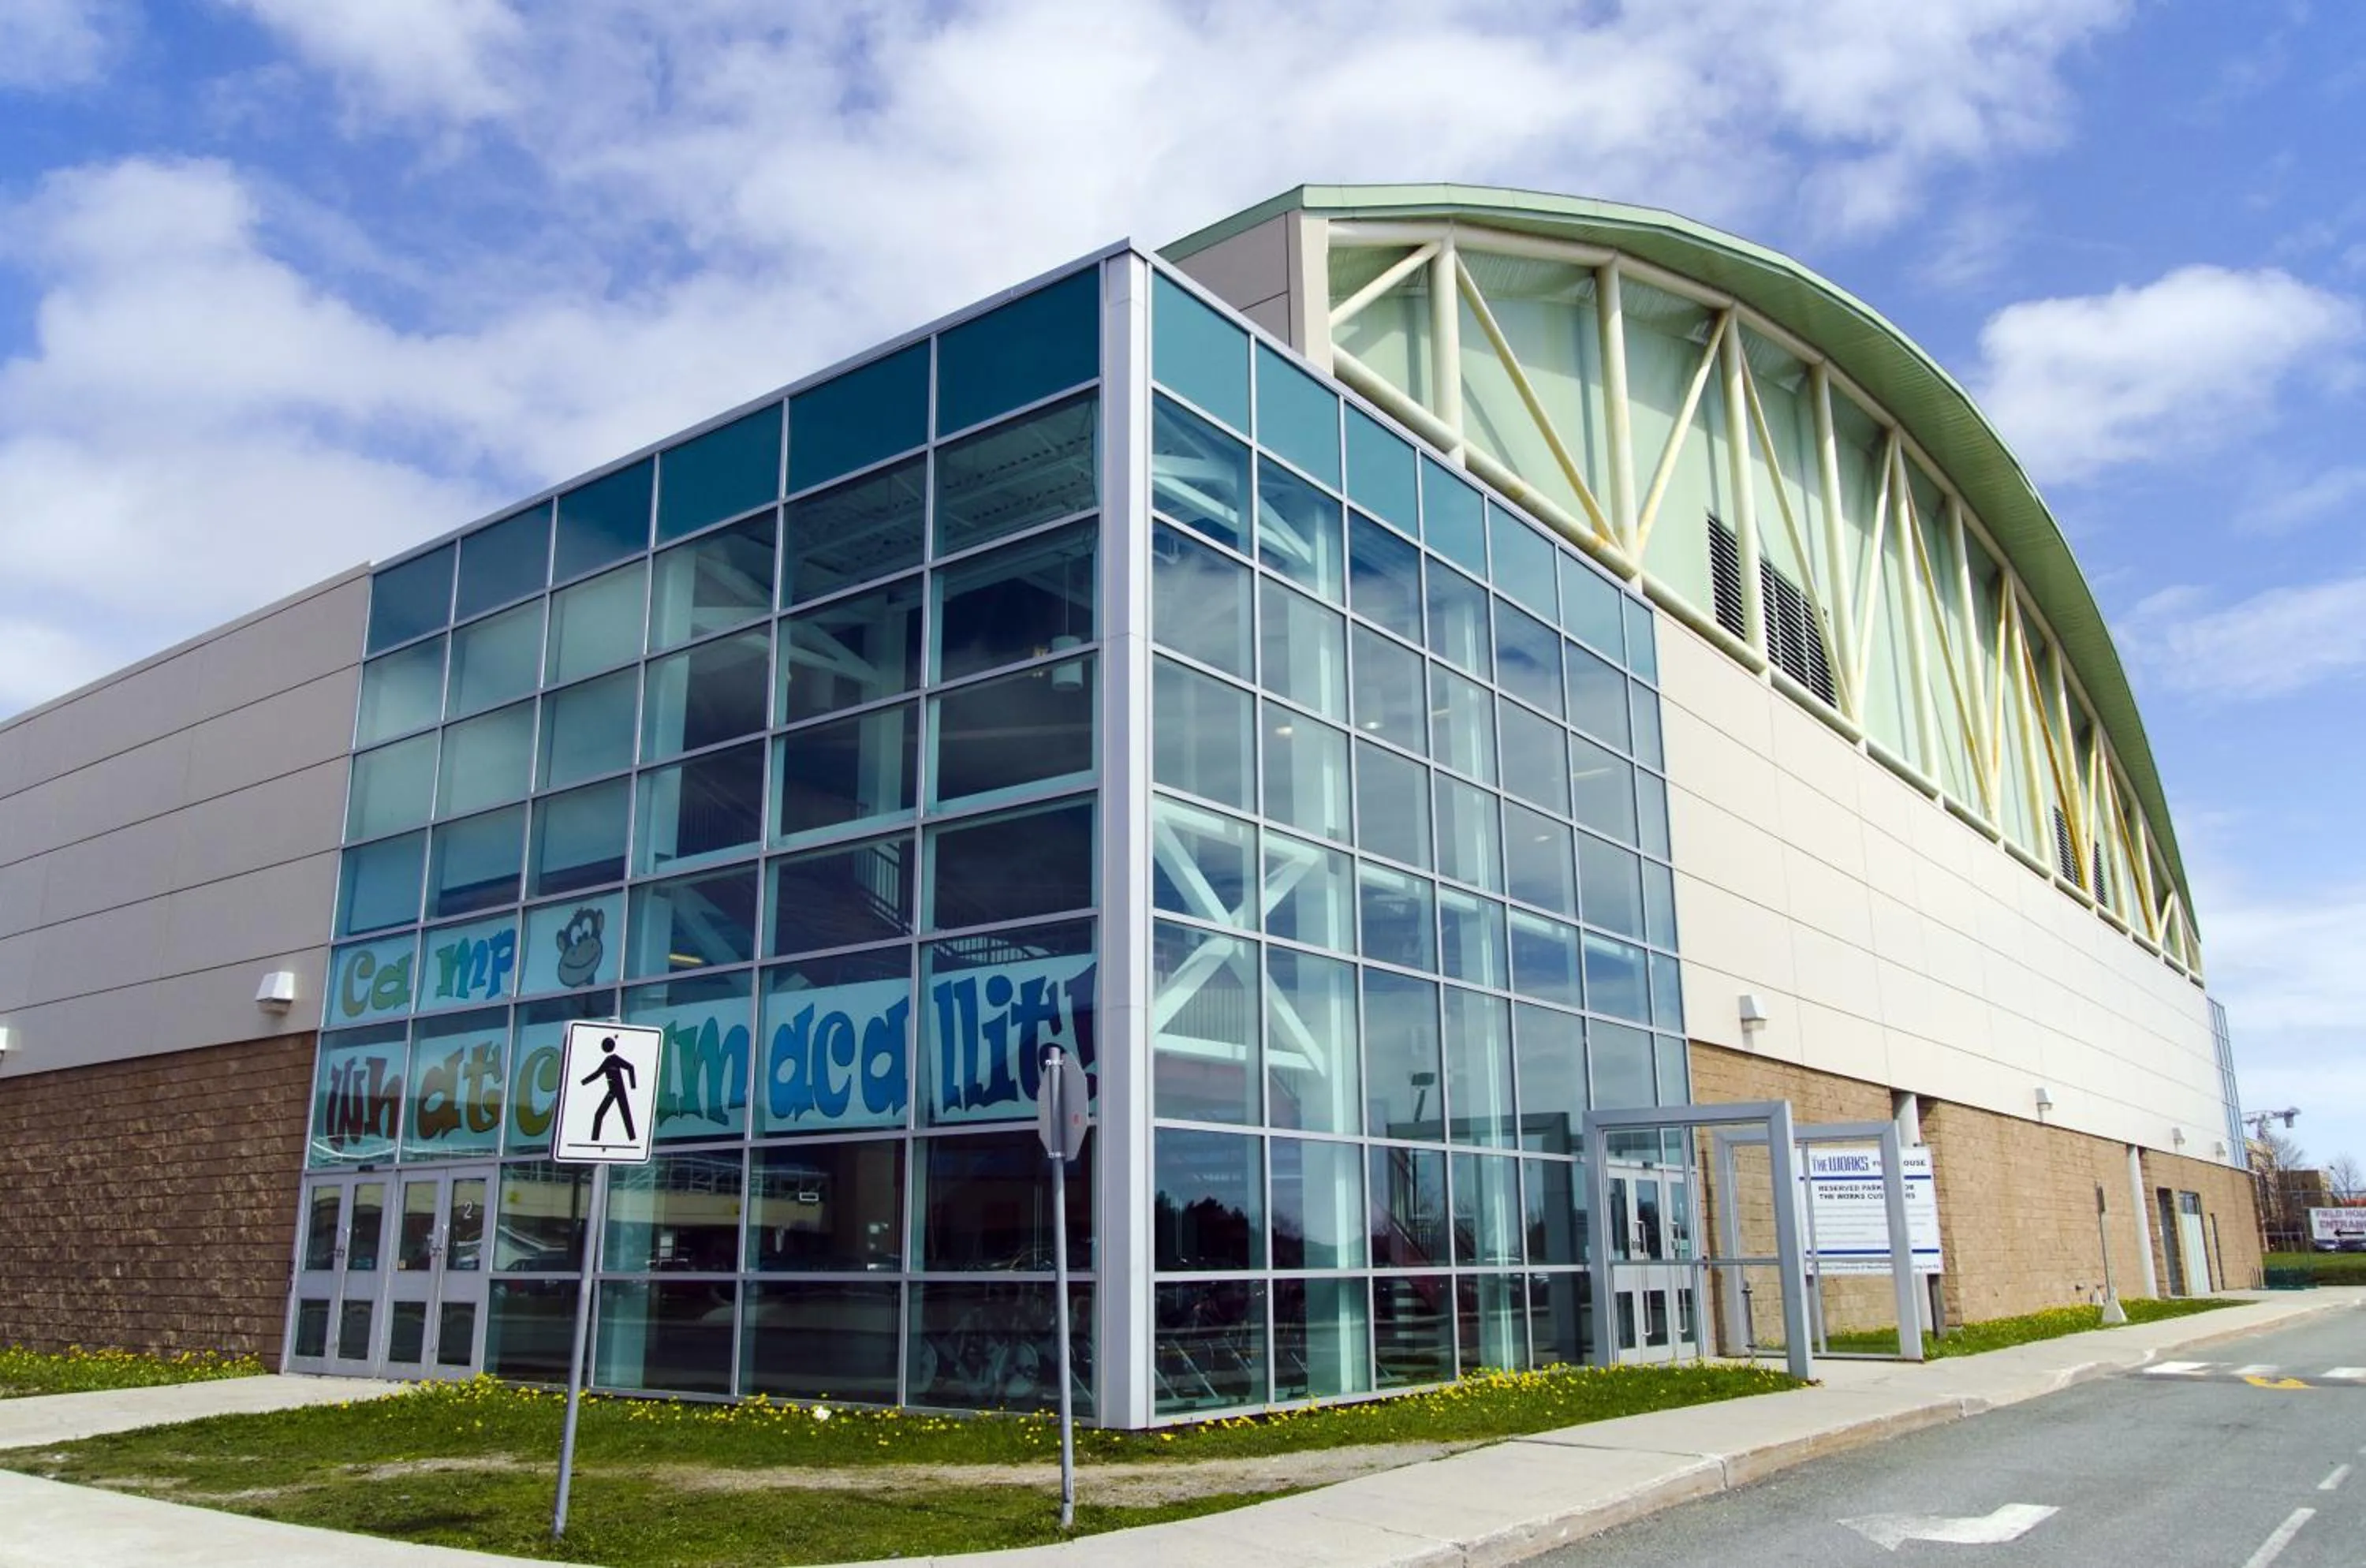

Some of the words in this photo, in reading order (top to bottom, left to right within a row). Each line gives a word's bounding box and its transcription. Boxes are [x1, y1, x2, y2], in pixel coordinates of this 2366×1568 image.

[342, 928, 517, 1017] Camp
[1828, 1156, 1868, 1171] WORKS
[463, 1201, 472, 1219] 2
